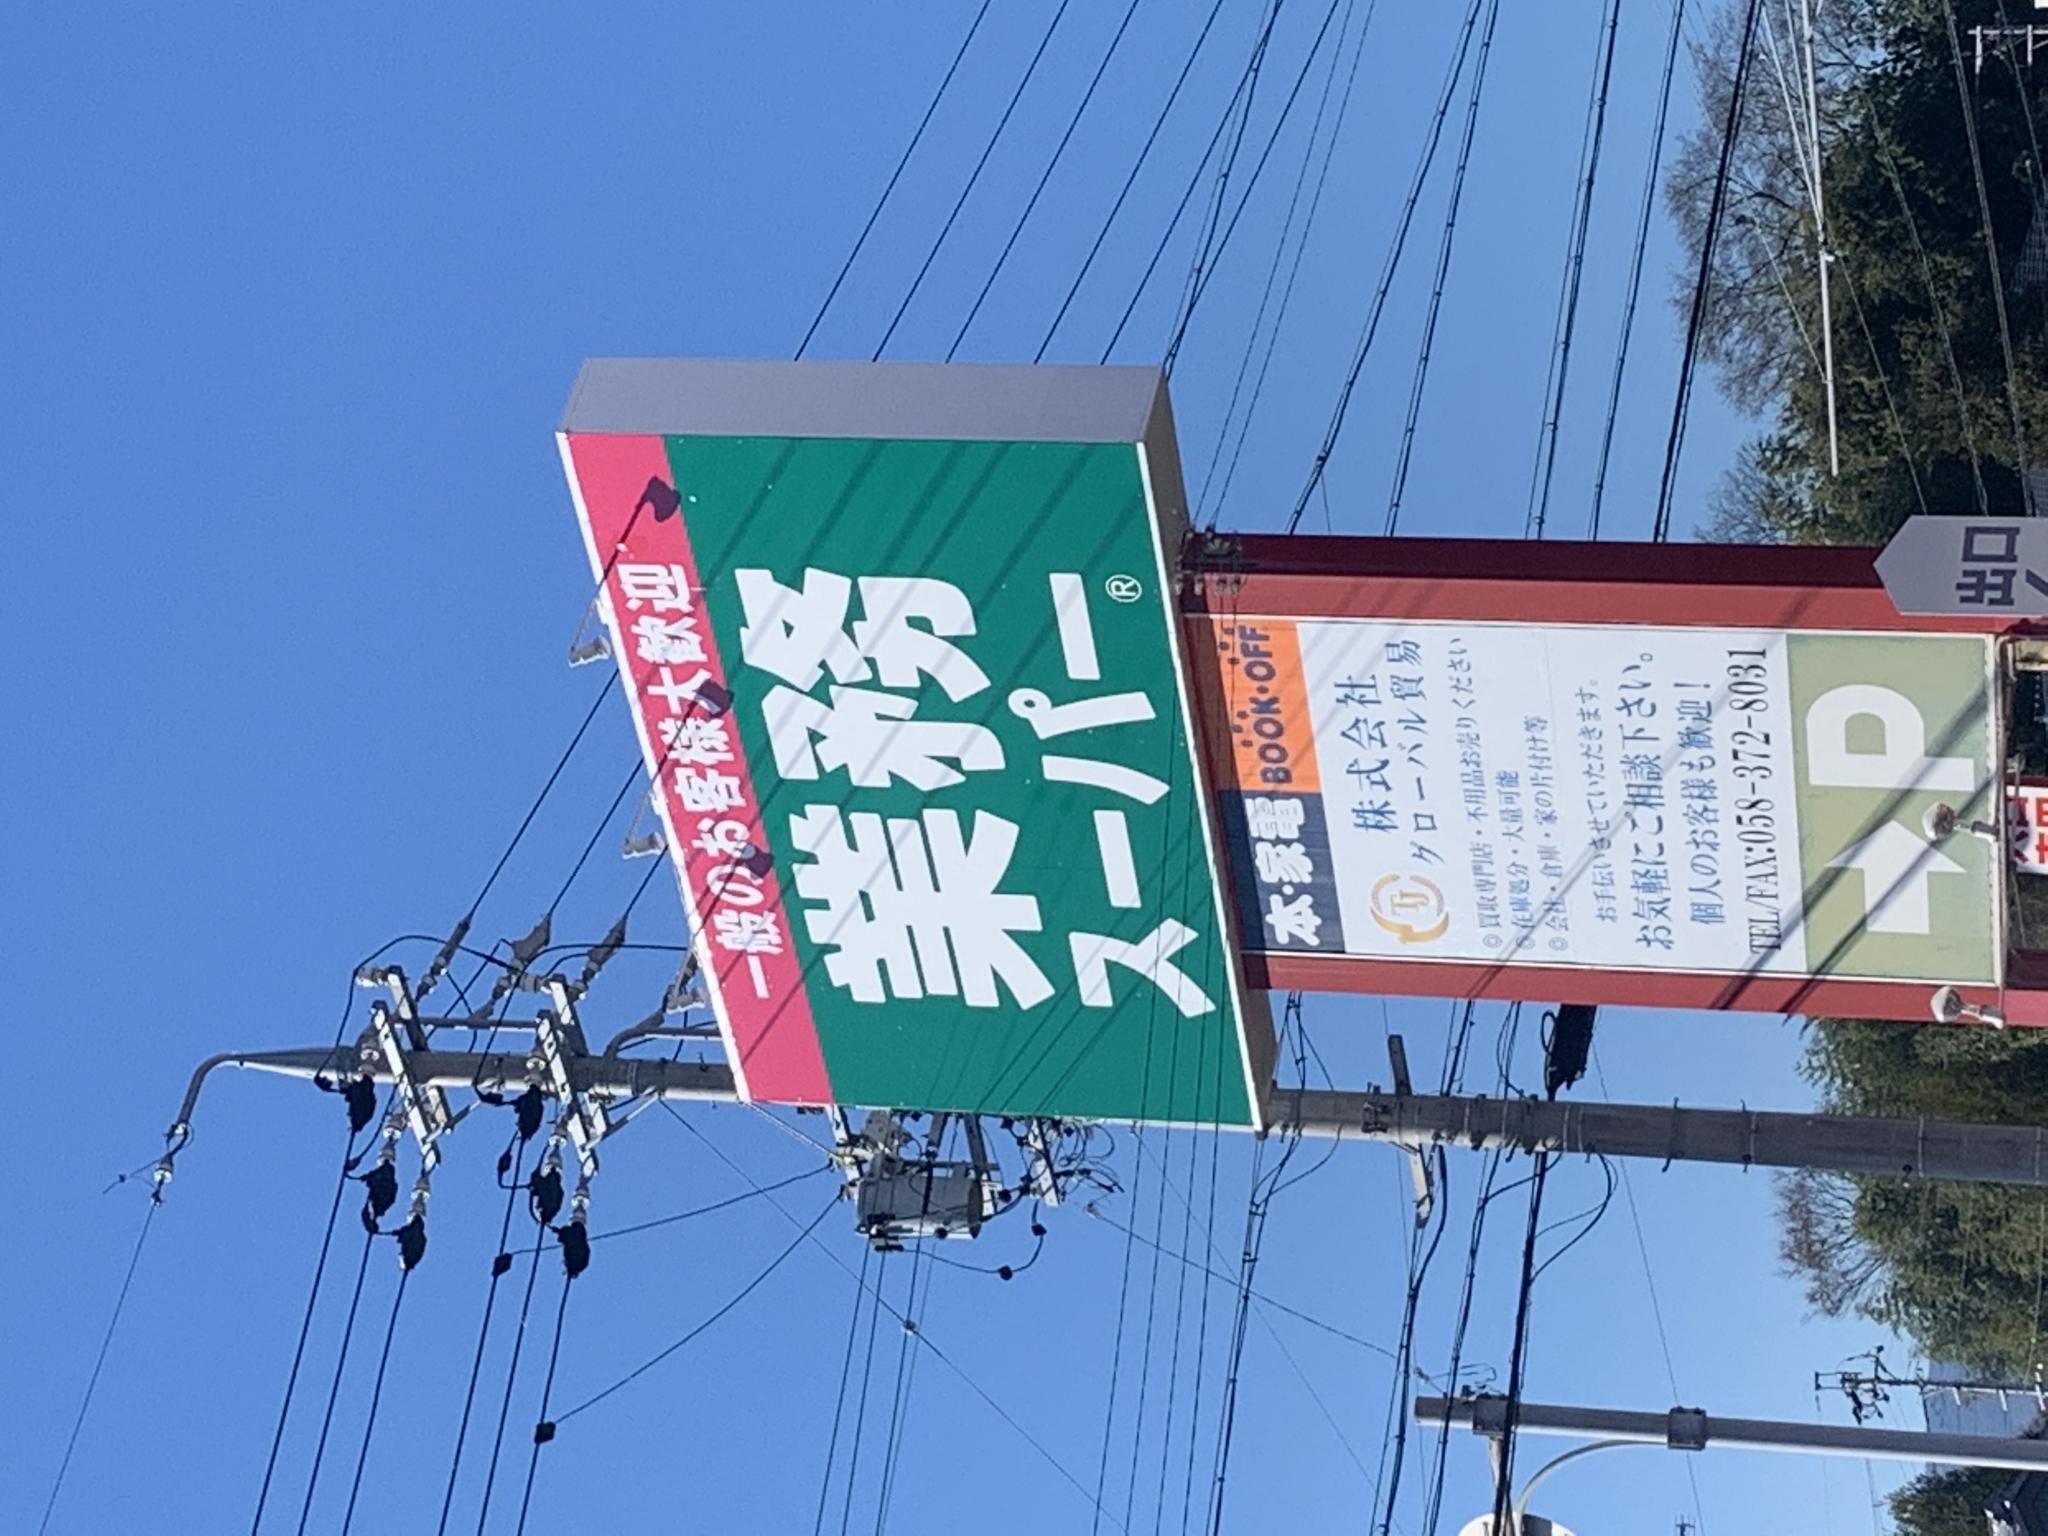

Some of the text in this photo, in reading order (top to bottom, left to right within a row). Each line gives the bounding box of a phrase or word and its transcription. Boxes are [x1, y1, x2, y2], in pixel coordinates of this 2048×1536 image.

[1956, 526, 2021, 606] 出口
[616, 563, 784, 999] 一般のお客様大歓迎
[735, 568, 1055, 1010] 業務
[1008, 572, 1217, 1018] スーパー
[1333, 673, 1399, 834] 株式会社
[1384, 638, 1446, 865] グローバル貿易
[1574, 678, 1619, 923] お手伝いさせていただきます。
[1615, 652, 1676, 950] お気軽にご相談下さい。
[1725, 646, 1783, 954] TEL/FAX:058-372-8031
[1806, 684, 1976, 792] P
[1245, 796, 1323, 946] 本・家電
